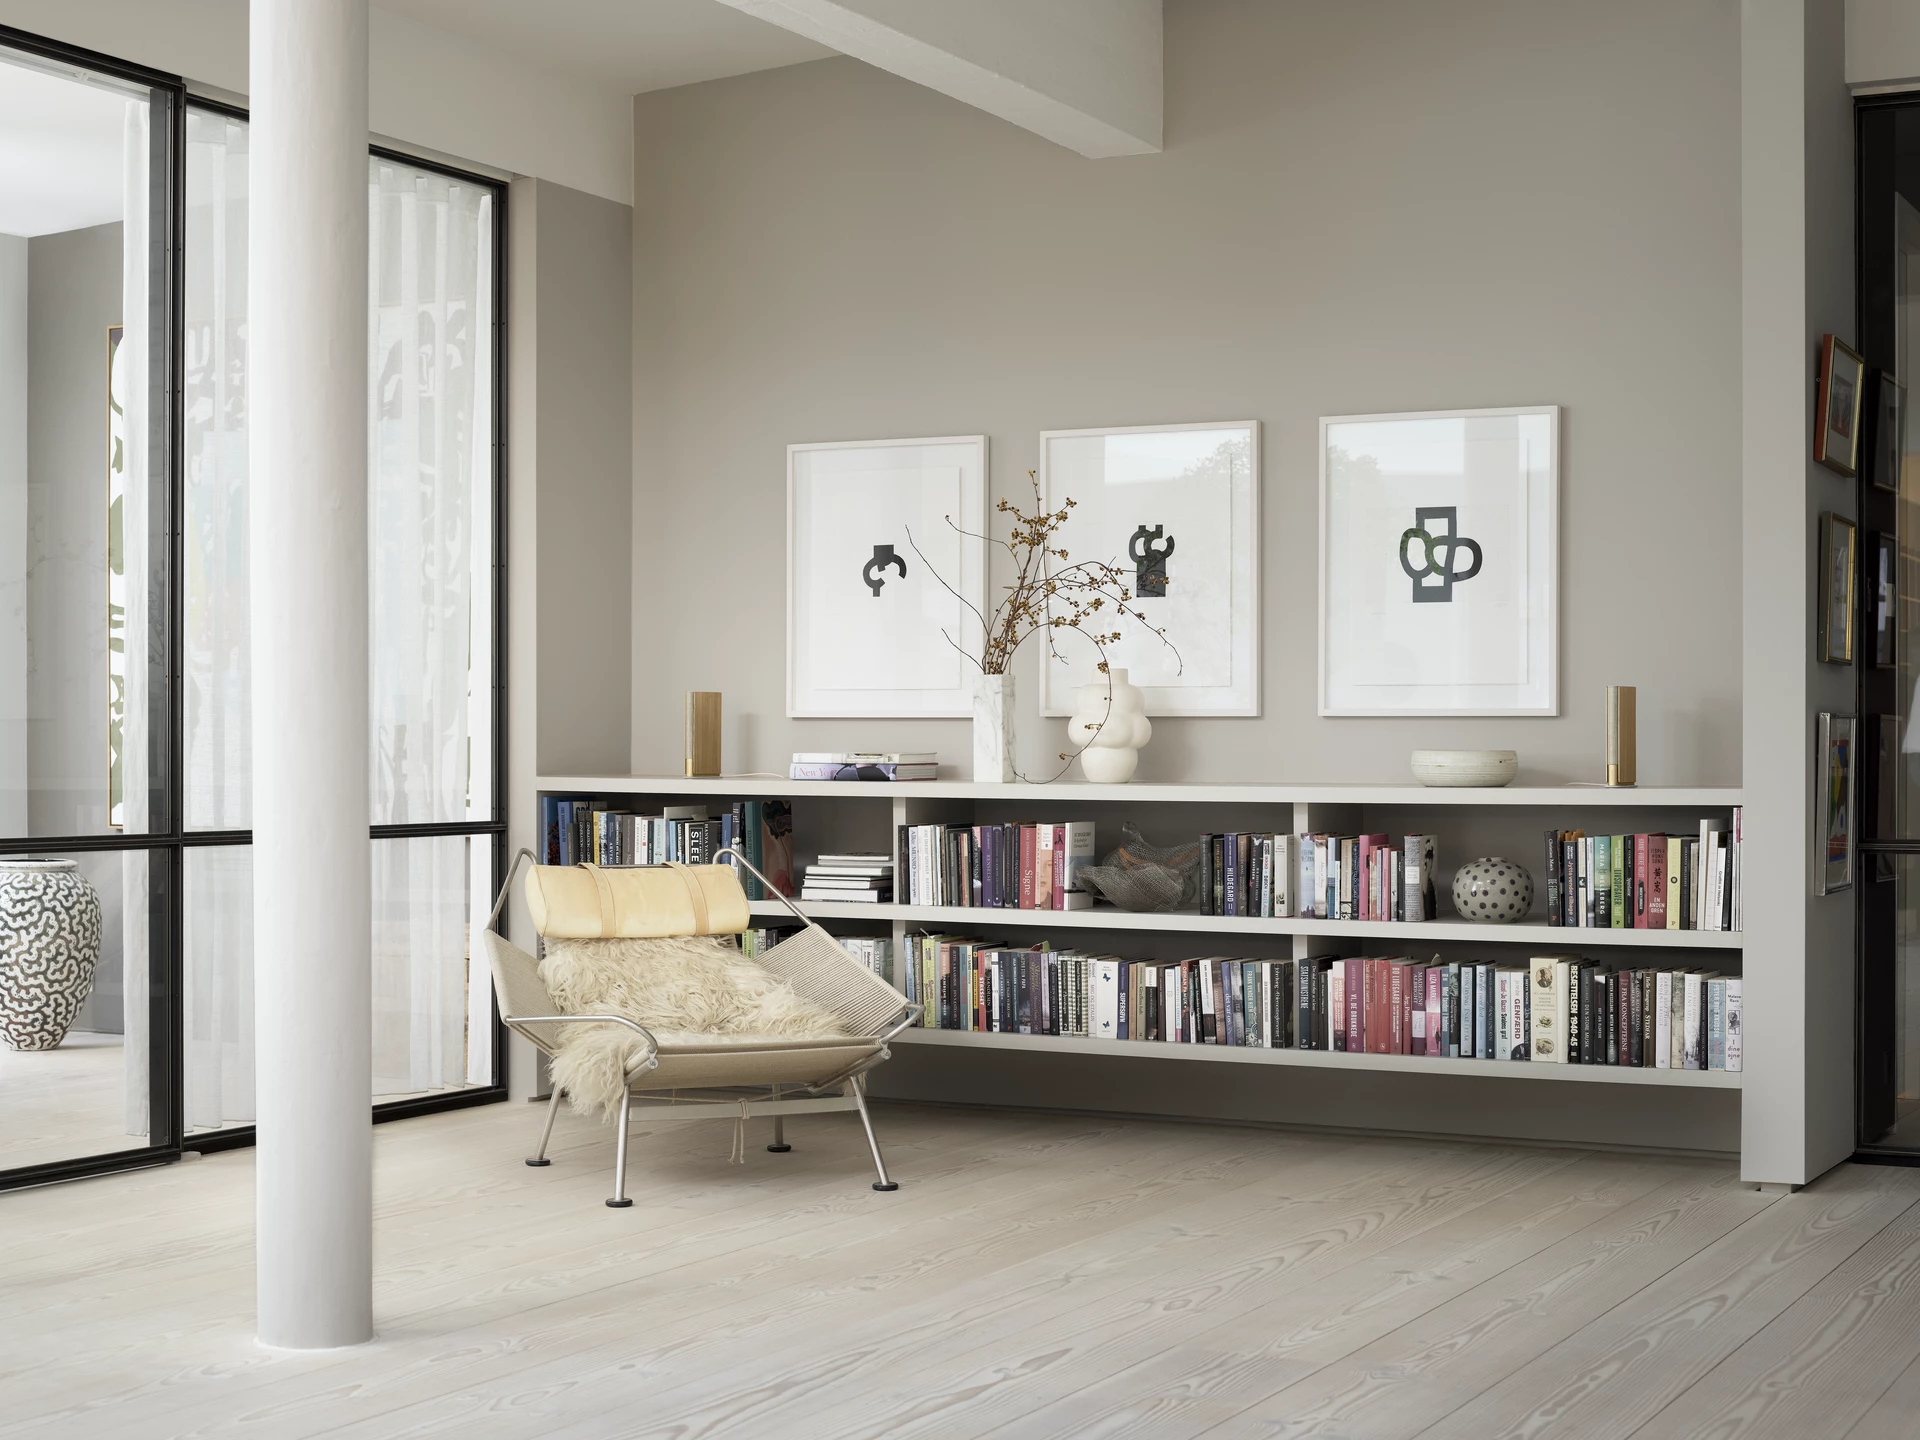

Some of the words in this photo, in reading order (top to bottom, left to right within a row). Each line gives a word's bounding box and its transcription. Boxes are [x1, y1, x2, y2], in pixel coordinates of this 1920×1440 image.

[799, 768, 818, 777] New
[1022, 870, 1032, 896] Signe
[1614, 870, 1622, 906] LIVSOPGAVER
[1300, 966, 1308, 1008] STATSMINISTRENE
[1392, 976, 1400, 1004] LIDEGAARD
